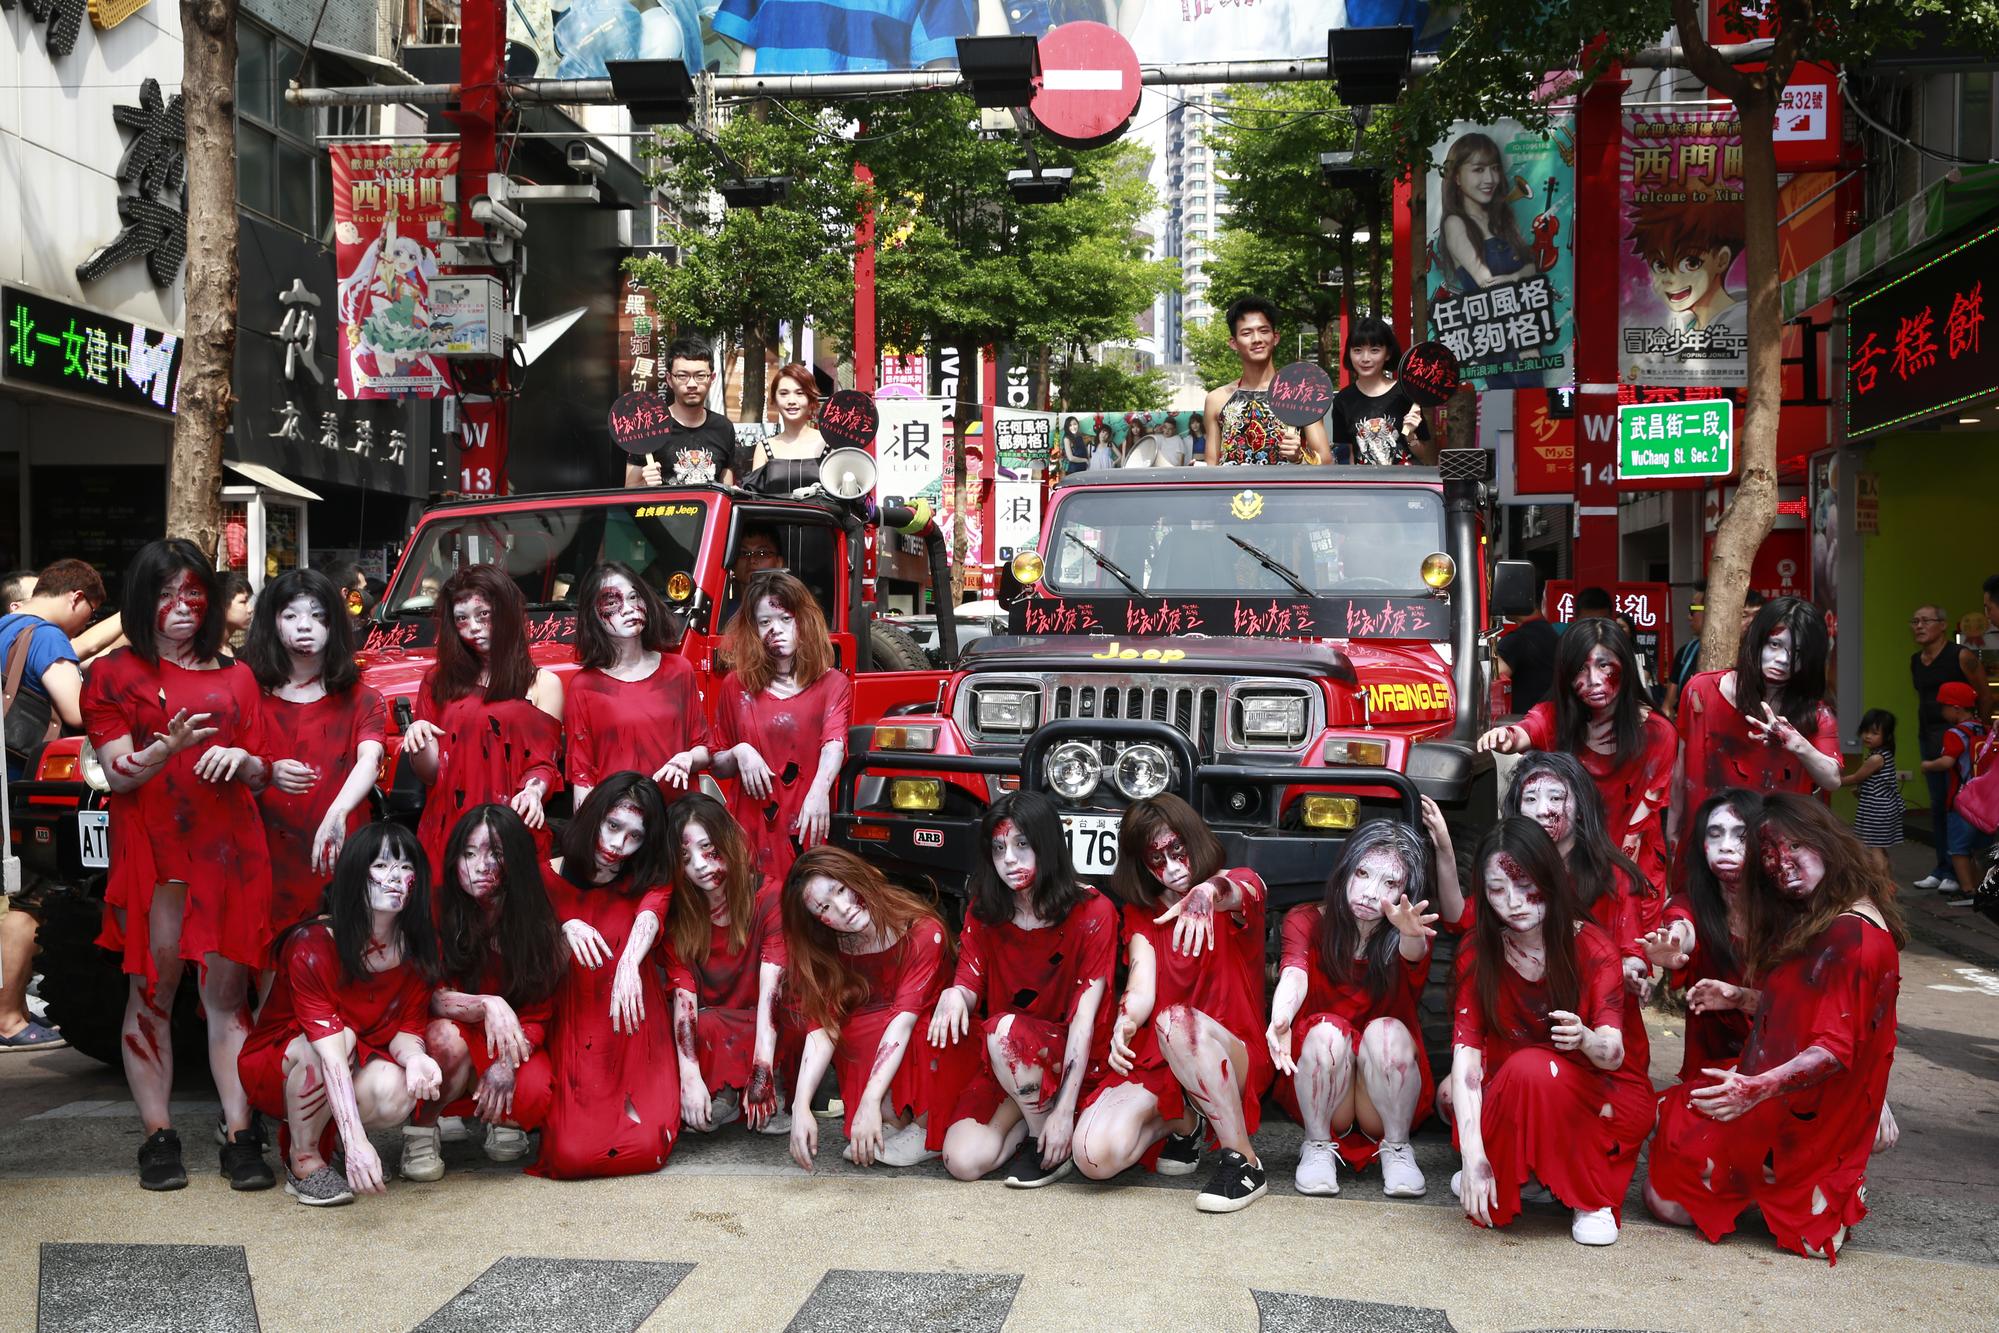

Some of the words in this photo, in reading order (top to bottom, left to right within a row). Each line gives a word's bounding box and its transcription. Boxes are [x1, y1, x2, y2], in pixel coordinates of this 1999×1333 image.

[1692, 190, 1706, 202] to
[1432, 278, 1550, 332] 任何風格
[462, 422, 489, 448] W
[997, 419, 1049, 435] 任何風格
[1583, 414, 1615, 443] W
[1629, 410, 1720, 441] 武昌街二段
[998, 433, 1048, 450] 都夠格!
[1630, 448, 1670, 469] WuChang
[1674, 446, 1686, 465] St.
[1690, 446, 1710, 464] Sec.
[1711, 445, 1718, 463] 2
[461, 467, 492, 491] 13
[1581, 462, 1616, 486] 14
[675, 504, 699, 516] Jeep
[982, 573, 994, 584] W
[1092, 642, 1186, 664] Jeep
[917, 831, 942, 843] ARB
